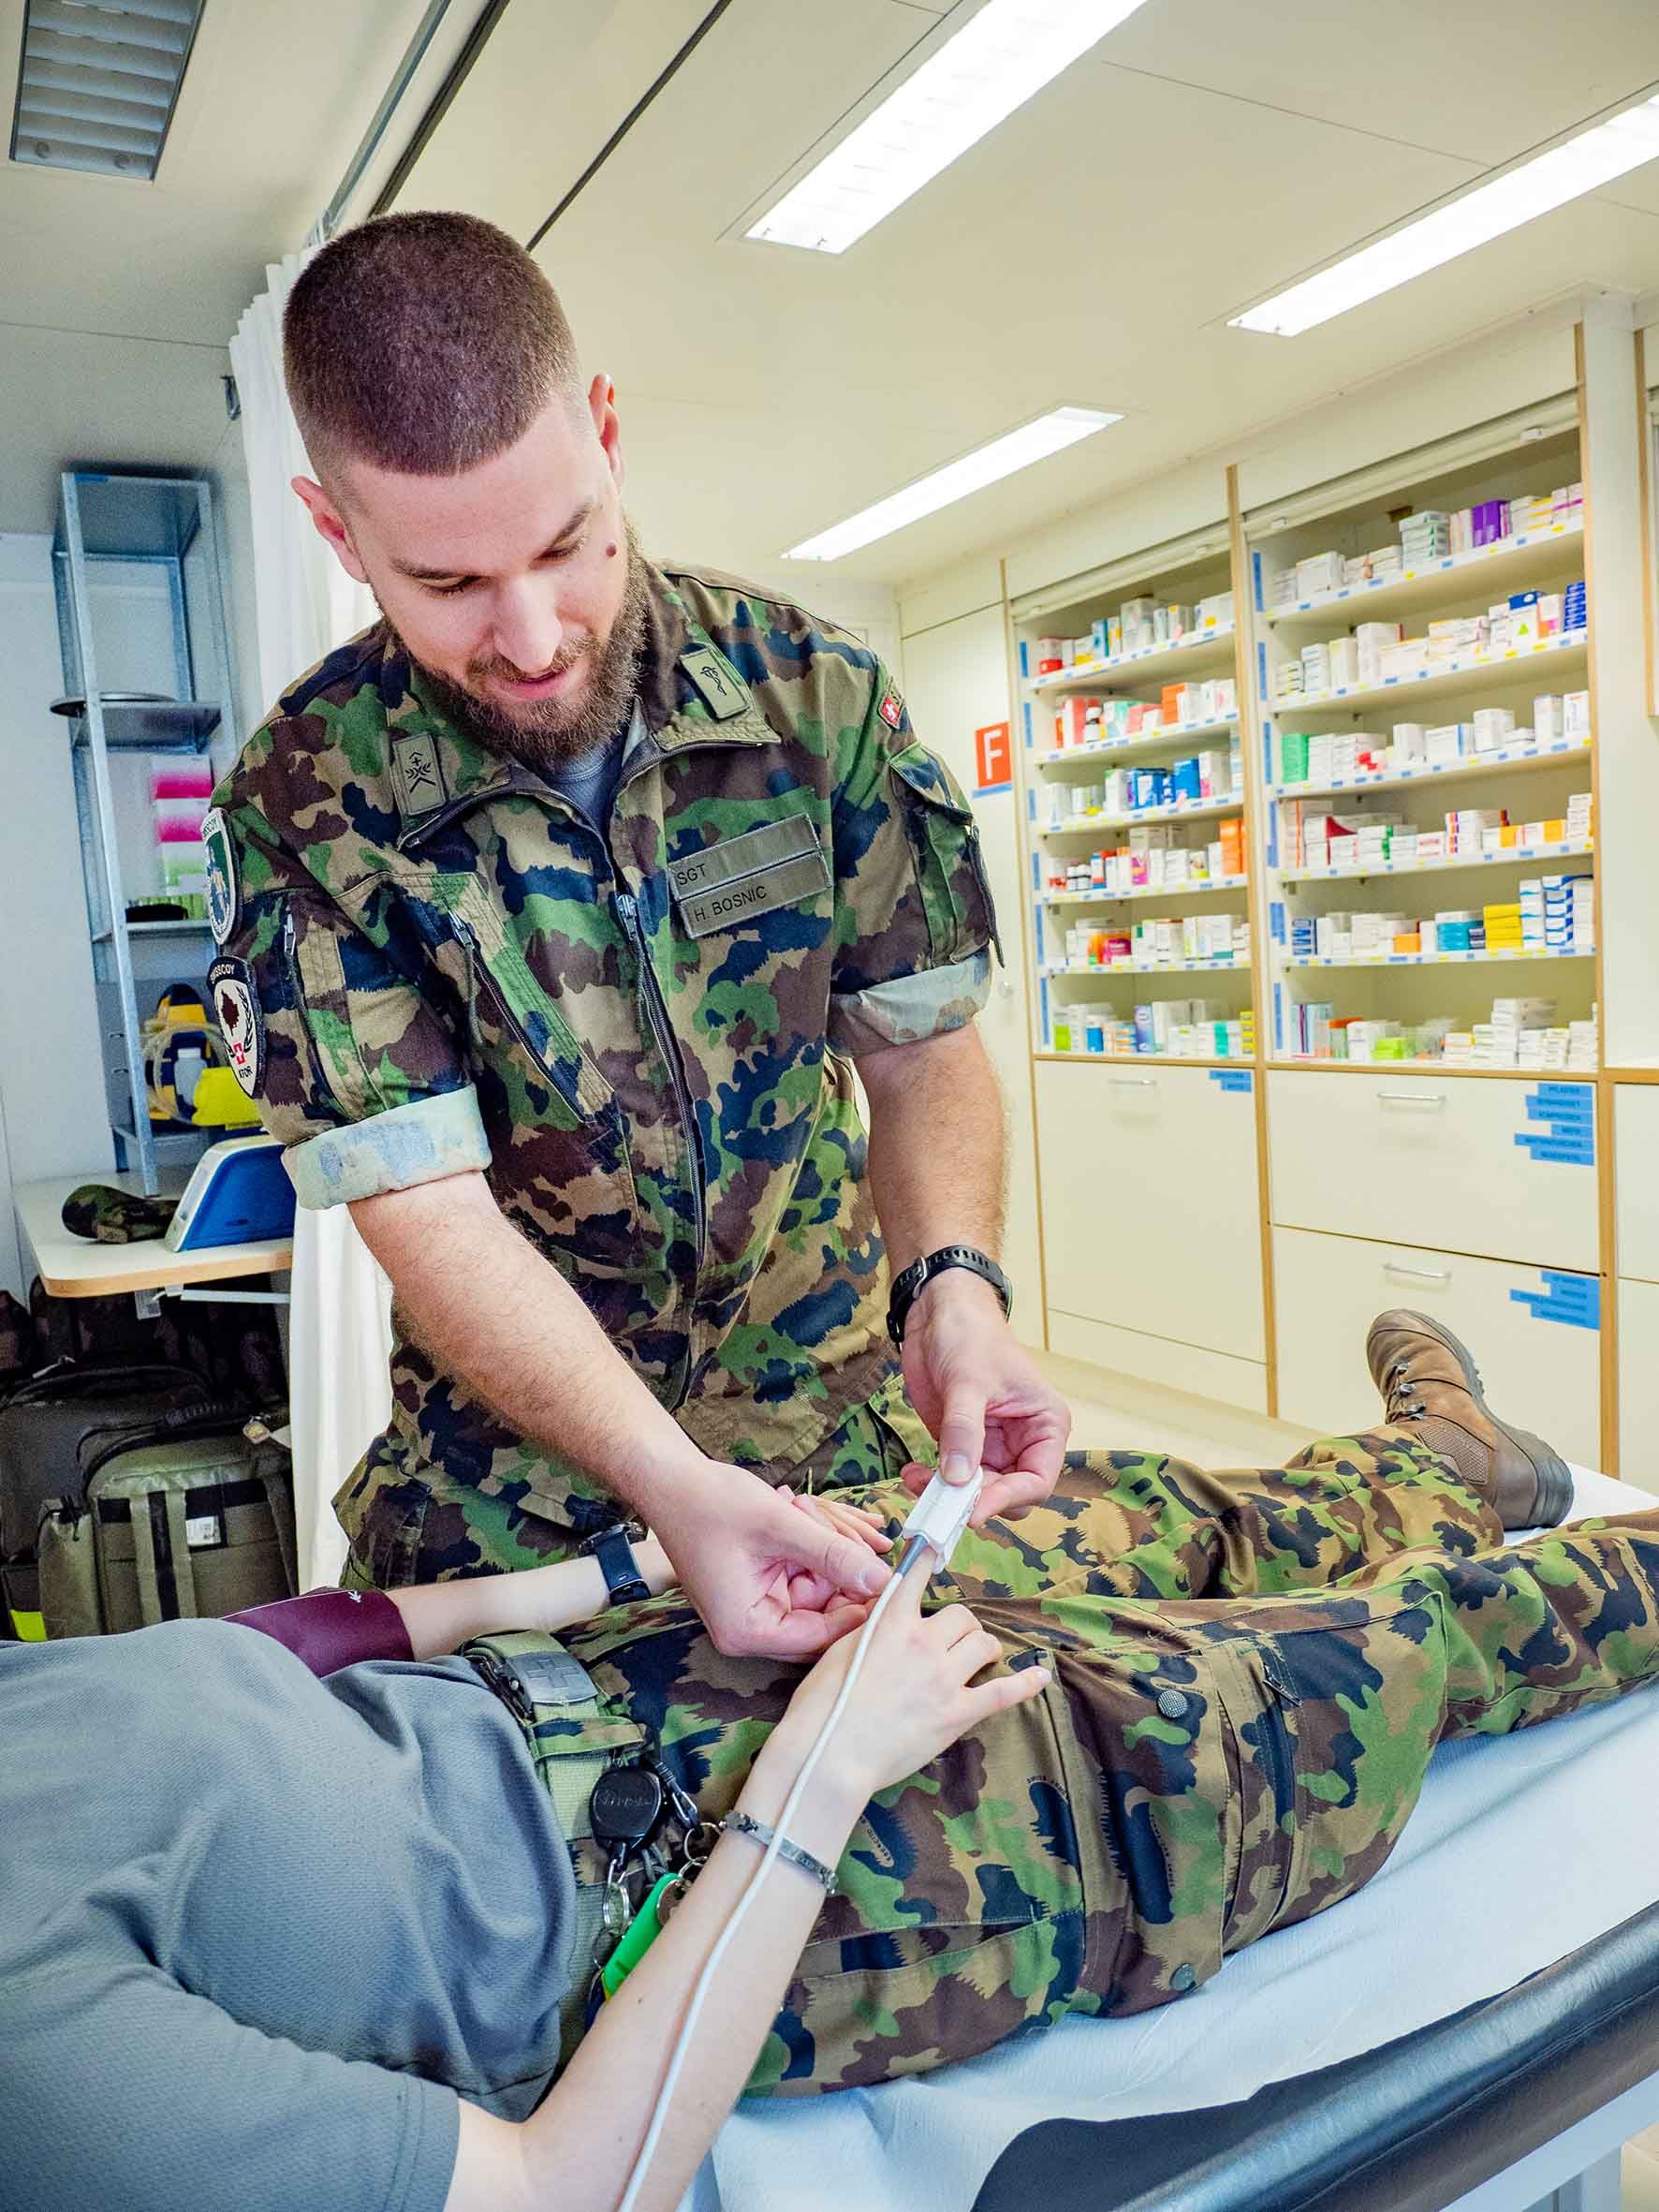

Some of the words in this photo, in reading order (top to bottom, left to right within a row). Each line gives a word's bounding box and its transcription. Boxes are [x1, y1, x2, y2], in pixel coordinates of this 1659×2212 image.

[983, 729, 1003, 780] F
[676, 863, 707, 886] SGT
[694, 907, 710, 922] H.
[712, 885, 768, 916] BOSNIC
[239, 1066, 253, 1079] KFOR
